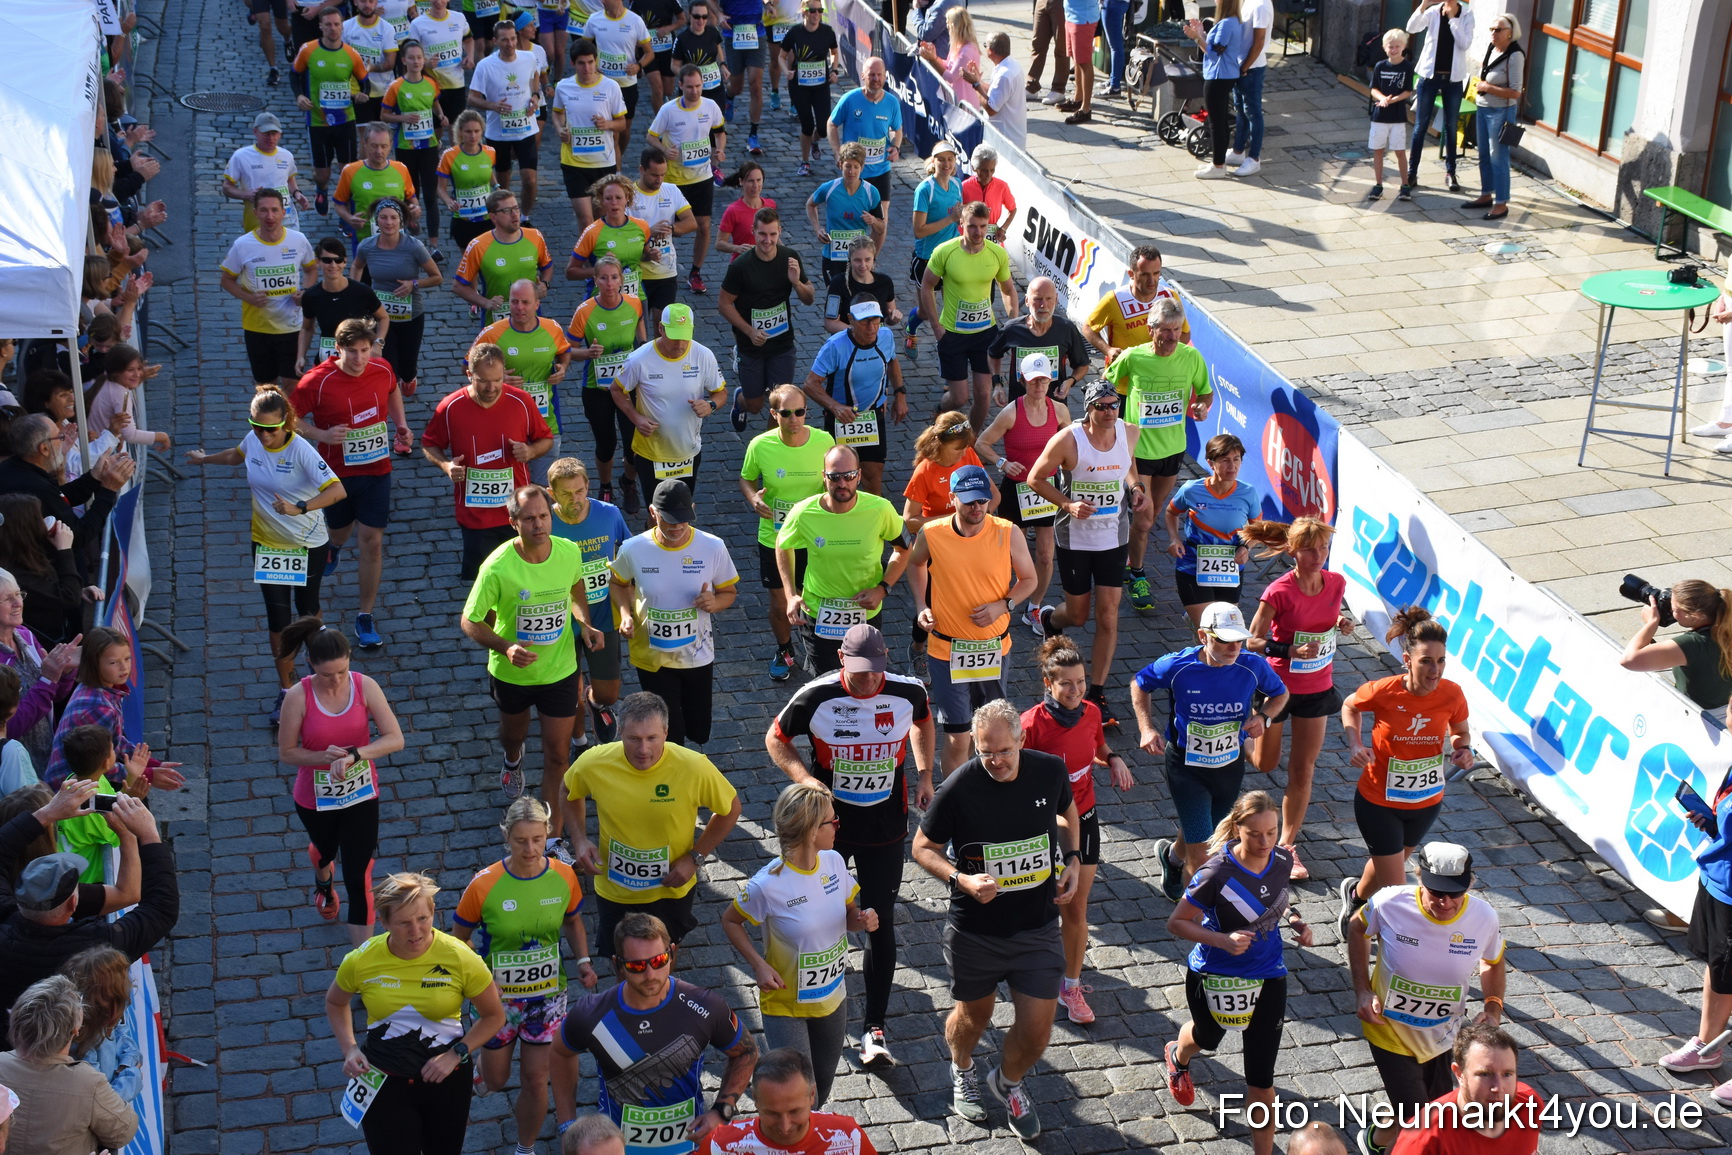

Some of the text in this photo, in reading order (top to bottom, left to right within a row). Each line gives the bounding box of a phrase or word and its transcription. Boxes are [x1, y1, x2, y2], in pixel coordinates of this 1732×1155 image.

[394, 24, 408, 33] 172
[438, 49, 458, 60] 670
[601, 61, 623, 70] 2201
[702, 72, 718, 82] 593
[801, 70, 824, 79] 2595
[323, 90, 348, 99] 2512
[504, 118, 528, 129] 2421
[575, 136, 601, 145] 2755
[686, 148, 710, 160] 2709
[867, 147, 883, 157] 126
[834, 241, 848, 251] 24
[1023, 206, 1077, 277] swn
[257, 265, 296, 277] BOCK
[261, 276, 292, 288] 1064
[385, 303, 408, 315] 257
[753, 303, 786, 318] BOCK
[958, 301, 990, 311] BOCK
[961, 311, 989, 322] 2675
[756, 317, 786, 331] 2674
[1144, 391, 1180, 402] BOCK
[1144, 402, 1180, 416] 2446
[1225, 400, 1247, 429] ONLINE
[841, 422, 873, 435] 1328
[349, 437, 384, 453] 2579
[1267, 418, 1329, 515] Hervis
[469, 470, 511, 480] BOCK
[470, 482, 508, 495] 2587
[1076, 482, 1116, 492] BOCK
[1027, 505, 1054, 516] JENNIFER
[1201, 547, 1235, 557] BOCK
[261, 556, 302, 571] 2618
[1202, 560, 1236, 572] 2459
[266, 573, 295, 581] MORAN
[521, 602, 566, 616] BOCK
[651, 609, 694, 621] BOCK
[523, 613, 563, 631] 2236
[822, 611, 861, 625] 2235
[527, 631, 560, 641] MARTIN
[653, 622, 692, 638] 2811
[955, 641, 999, 651] BOCK
[957, 652, 996, 668] 1357
[1190, 702, 1243, 714] SYSCAD
[1193, 724, 1235, 738] BOCK
[829, 740, 903, 762] TRI-TEAM
[1193, 736, 1234, 754] 2142
[1196, 753, 1231, 763] JOHANN
[838, 761, 889, 773] BOCK
[1393, 758, 1438, 772] BOCK
[322, 774, 365, 797] 2221
[840, 775, 888, 792] 2747
[1394, 769, 1438, 789] 2738
[613, 844, 662, 861] BOCK
[991, 838, 1044, 857] BOCK
[614, 857, 662, 878] 2063
[994, 853, 1044, 876] 1145
[624, 878, 650, 887] HANS
[1003, 874, 1037, 887] ANDRÉ
[1450, 934, 1463, 943] 20
[501, 949, 552, 964] BOCK
[804, 939, 847, 966] BOCK
[502, 964, 552, 983] 1280
[807, 956, 845, 987] 2745
[501, 981, 552, 993] MICHAELA
[1208, 977, 1262, 989] BOCK
[1395, 978, 1456, 1000] BOCK
[678, 992, 711, 1020] C. GROH
[1212, 993, 1258, 1012] 1334
[1393, 995, 1451, 1018] 2776
[348, 1077, 368, 1104] 78
[627, 1103, 692, 1124] BOCK
[628, 1121, 688, 1144] 2707
